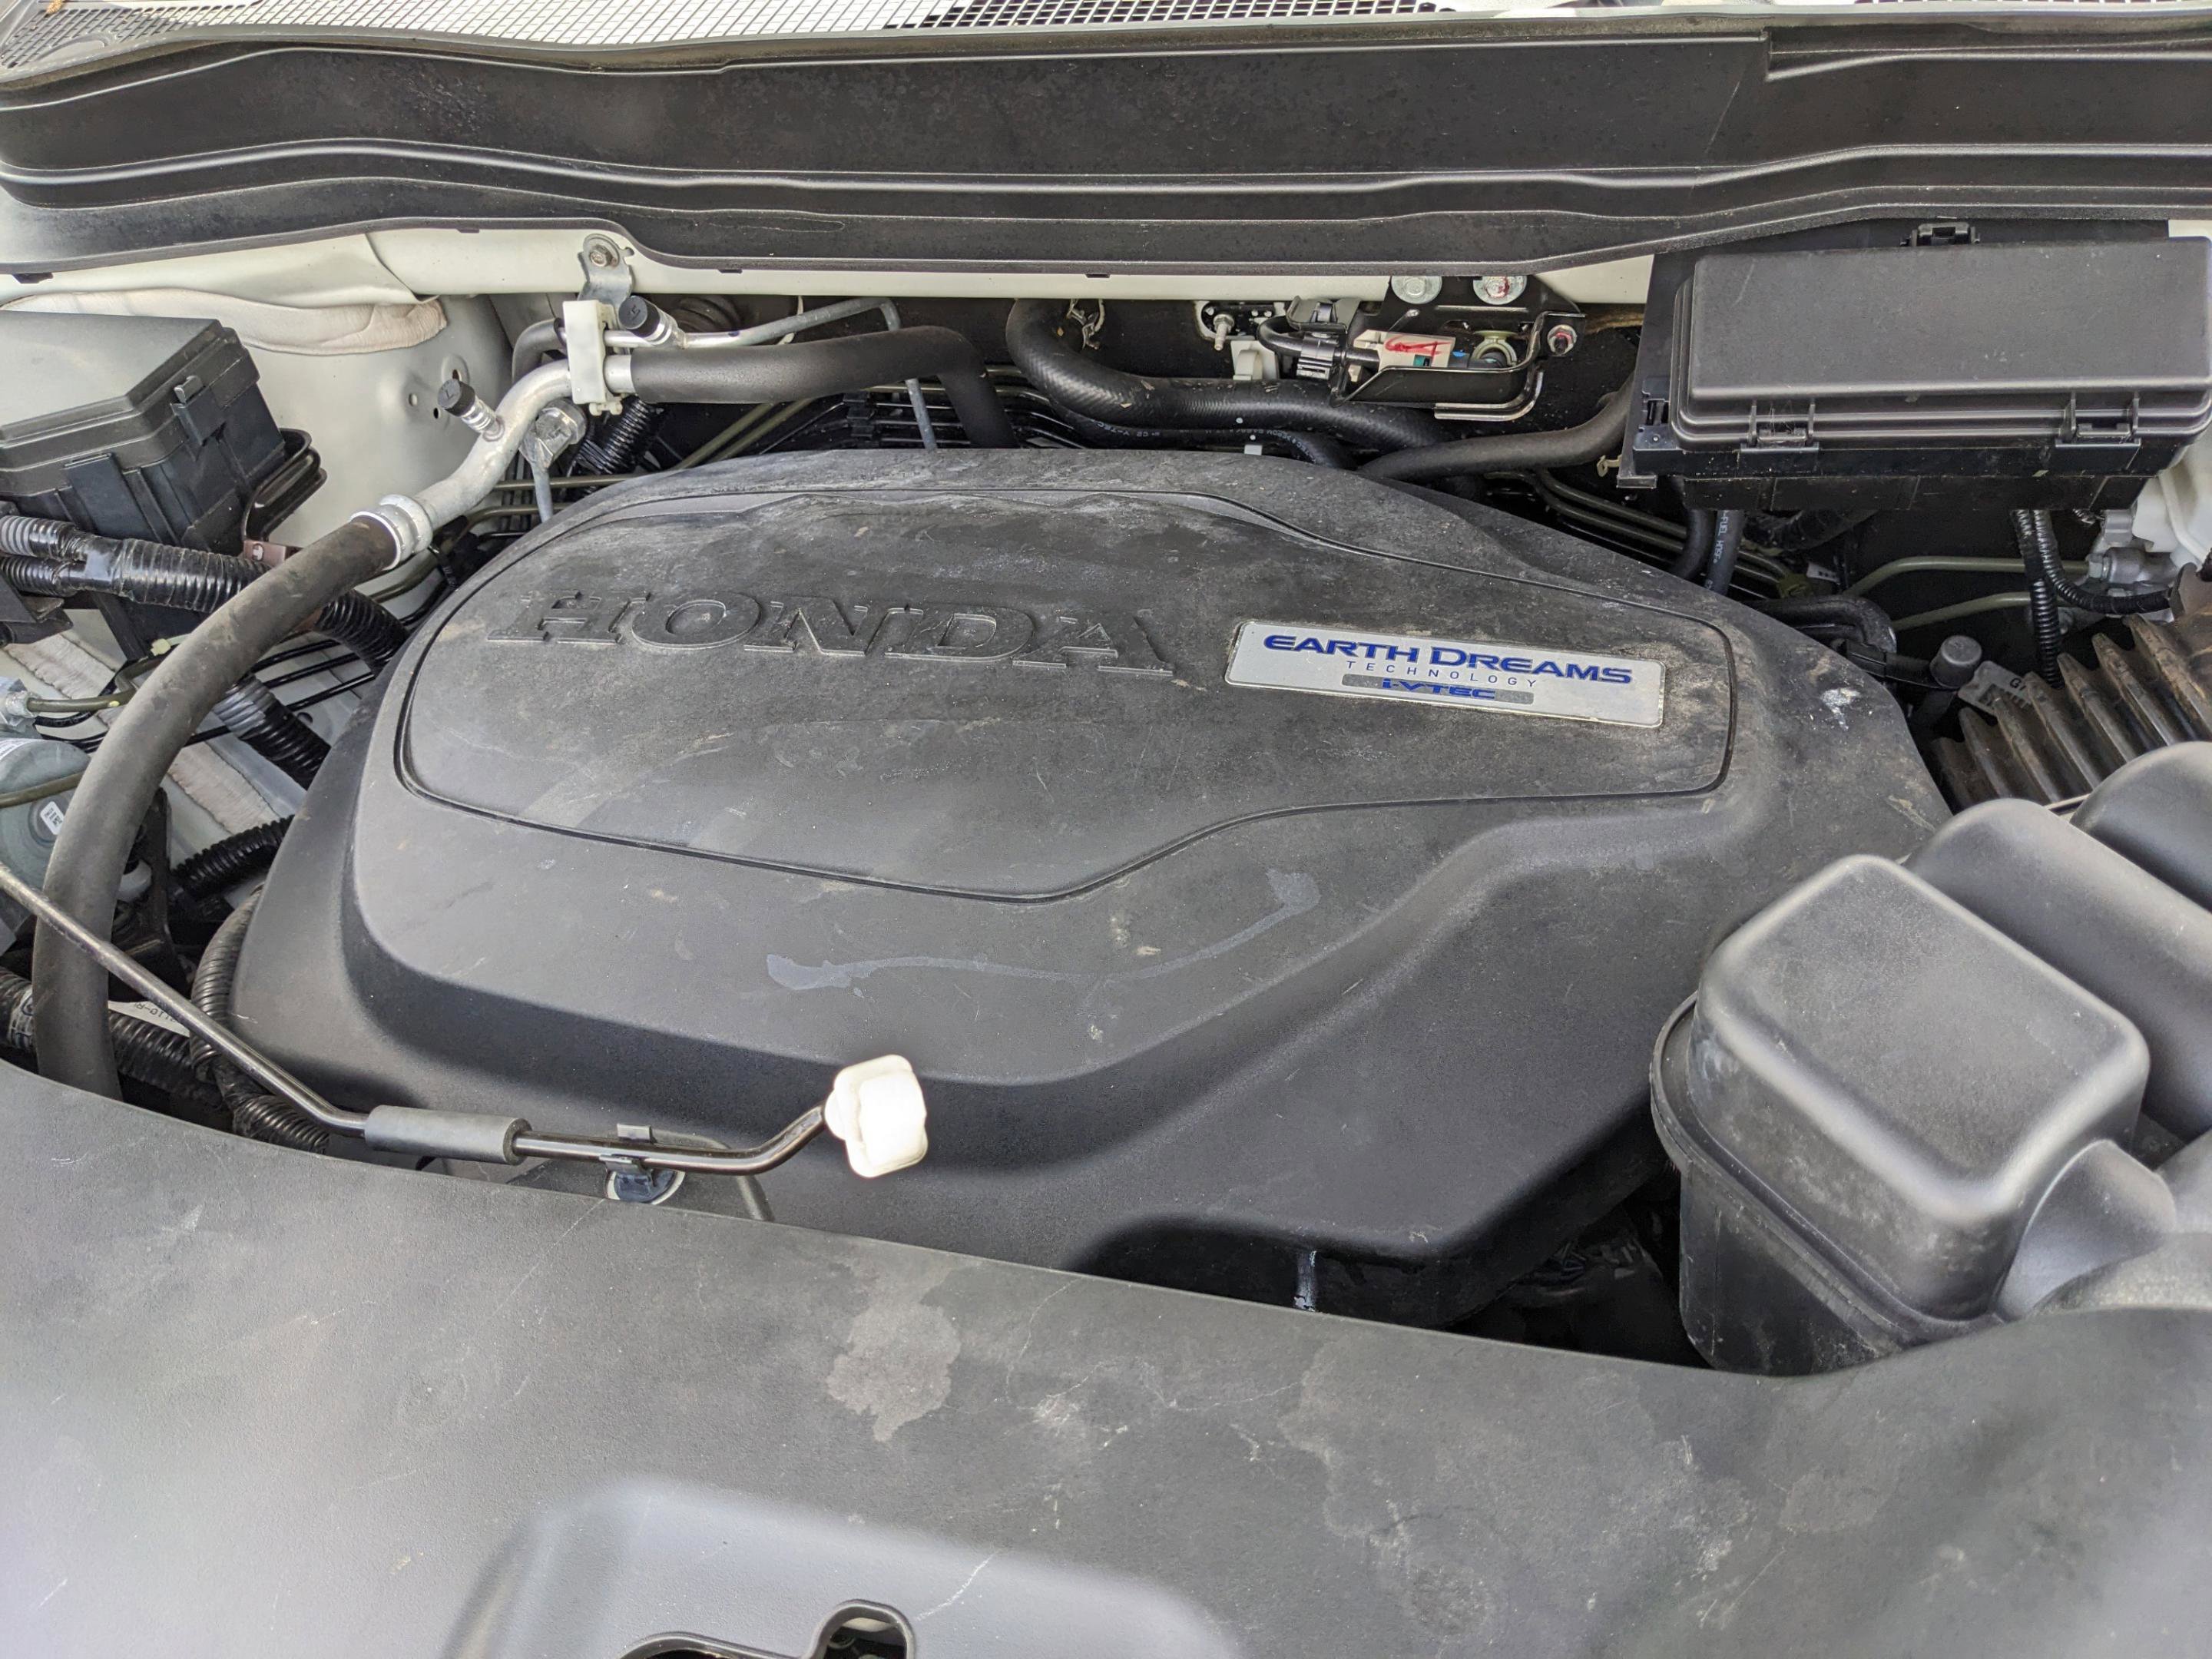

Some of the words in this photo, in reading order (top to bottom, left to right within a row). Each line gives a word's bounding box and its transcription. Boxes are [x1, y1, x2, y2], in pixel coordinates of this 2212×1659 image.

[487, 589, 1175, 676] HONDA
[1263, 634, 1419, 663] EARTH
[1430, 646, 1633, 685] DREAMS
[1346, 660, 1537, 688] TECHNOLOGY
[1382, 678, 1496, 700] i-VTEC
